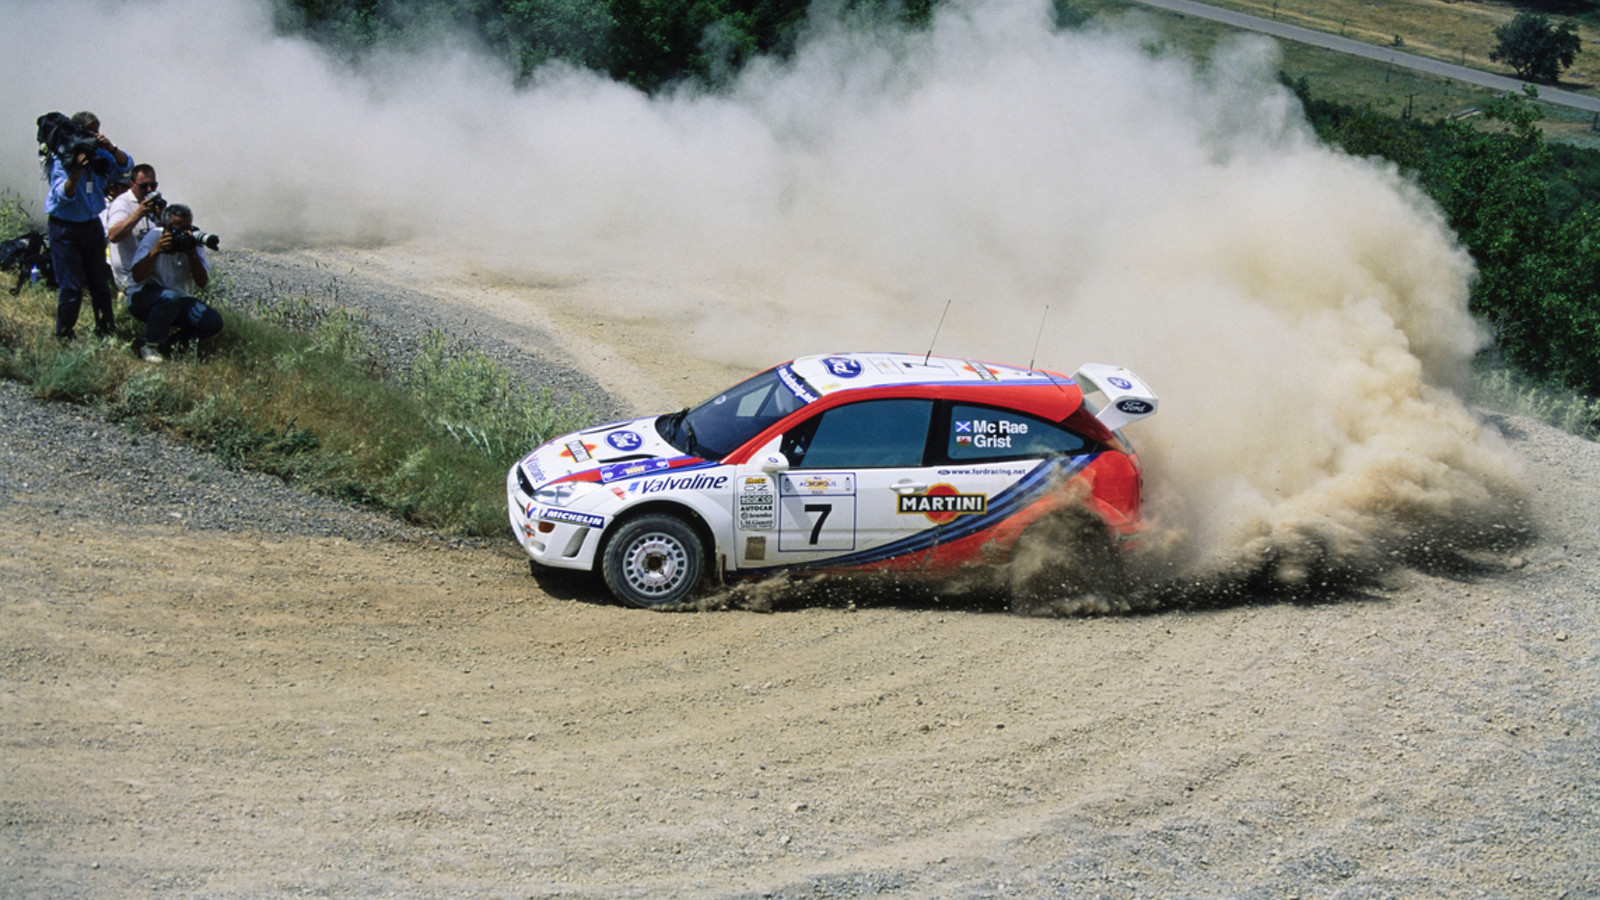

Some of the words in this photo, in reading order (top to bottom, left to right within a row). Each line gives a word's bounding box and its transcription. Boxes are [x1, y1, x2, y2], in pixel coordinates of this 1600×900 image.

[1121, 400, 1146, 412] Ford
[973, 420, 996, 434] Mc
[999, 420, 1028, 434] Rae
[973, 434, 1012, 448] Grist
[951, 468, 1026, 477] www.fordracing.net
[642, 473, 728, 494] Valvoline
[902, 496, 981, 511] MARTINI
[547, 509, 603, 525] MICHELIN
[804, 503, 833, 546] 7
